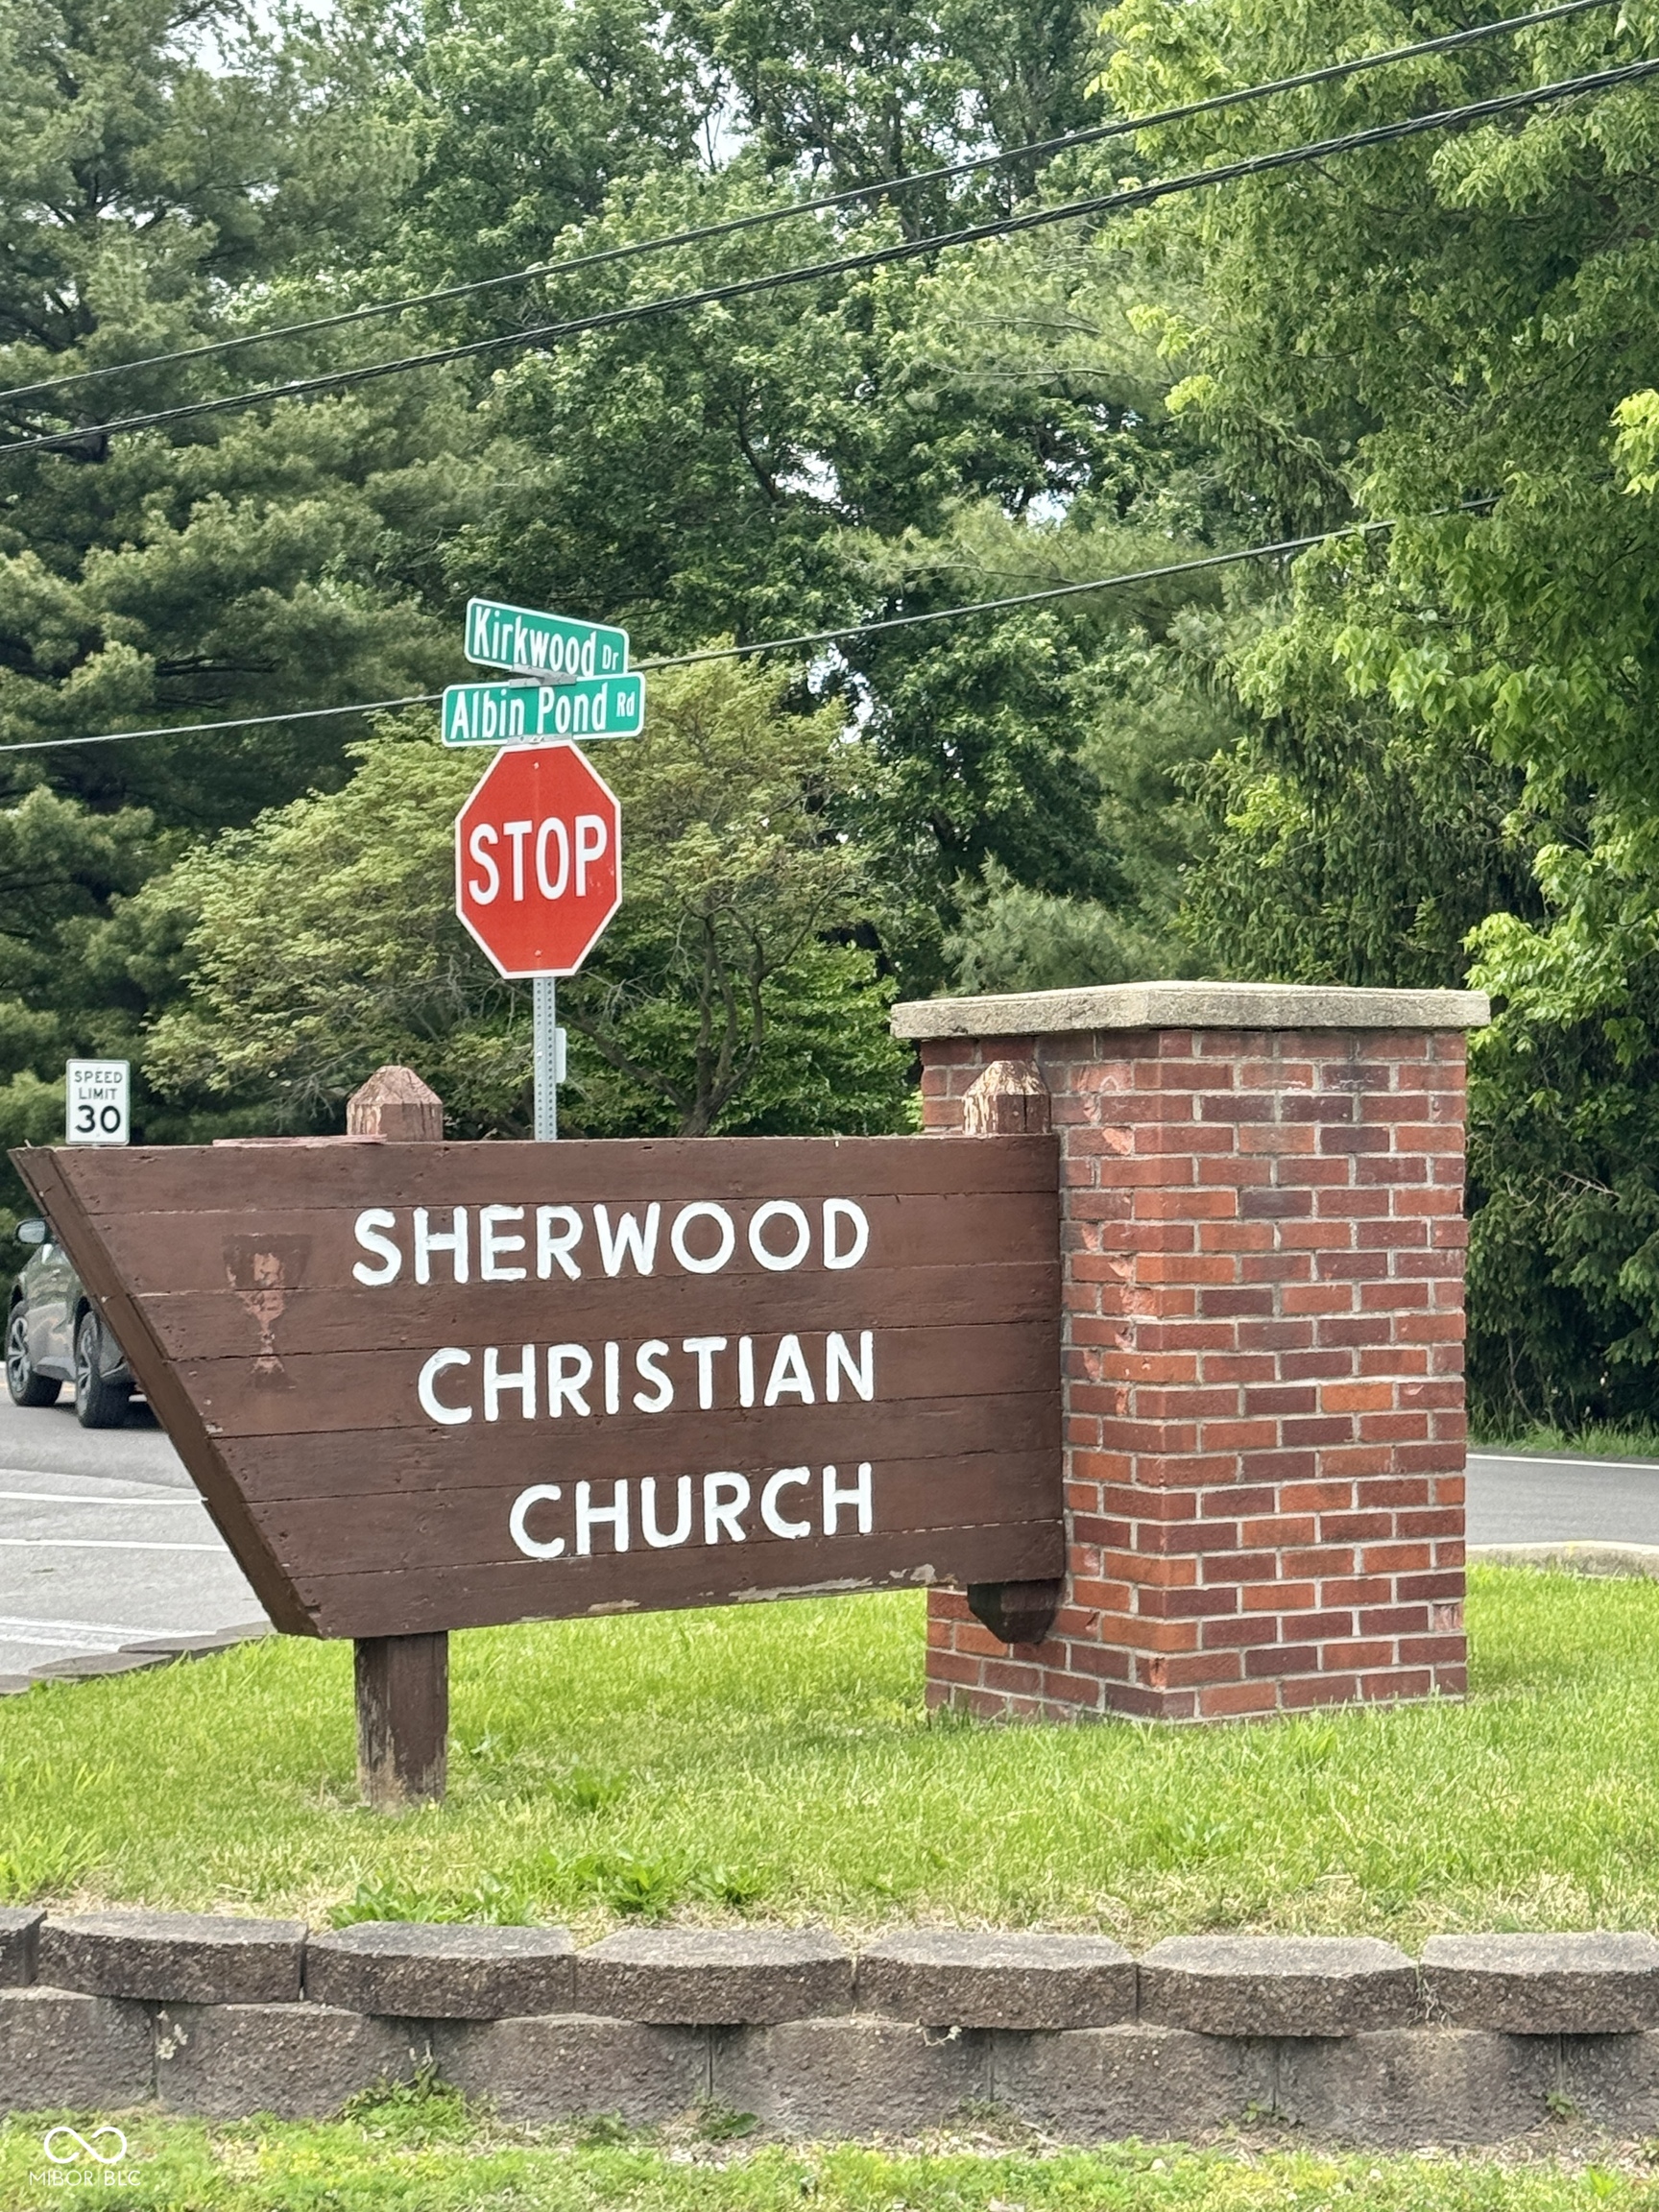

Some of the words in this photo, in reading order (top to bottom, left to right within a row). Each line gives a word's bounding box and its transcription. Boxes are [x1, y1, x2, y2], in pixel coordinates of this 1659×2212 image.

[473, 606, 596, 677] Kirkwood
[602, 644, 619, 670] Dr
[450, 688, 525, 739] Albin
[537, 682, 608, 734] Pond
[616, 691, 636, 717] Rd
[469, 814, 608, 905] STOP
[74, 1070, 123, 1083] SPEED
[78, 1087, 117, 1100] LIMIT
[75, 1104, 121, 1134] 30
[351, 1198, 870, 1286] SHERWOOD
[418, 1331, 875, 1425] CHRISTIAN
[509, 1462, 873, 1559] CHURCH
